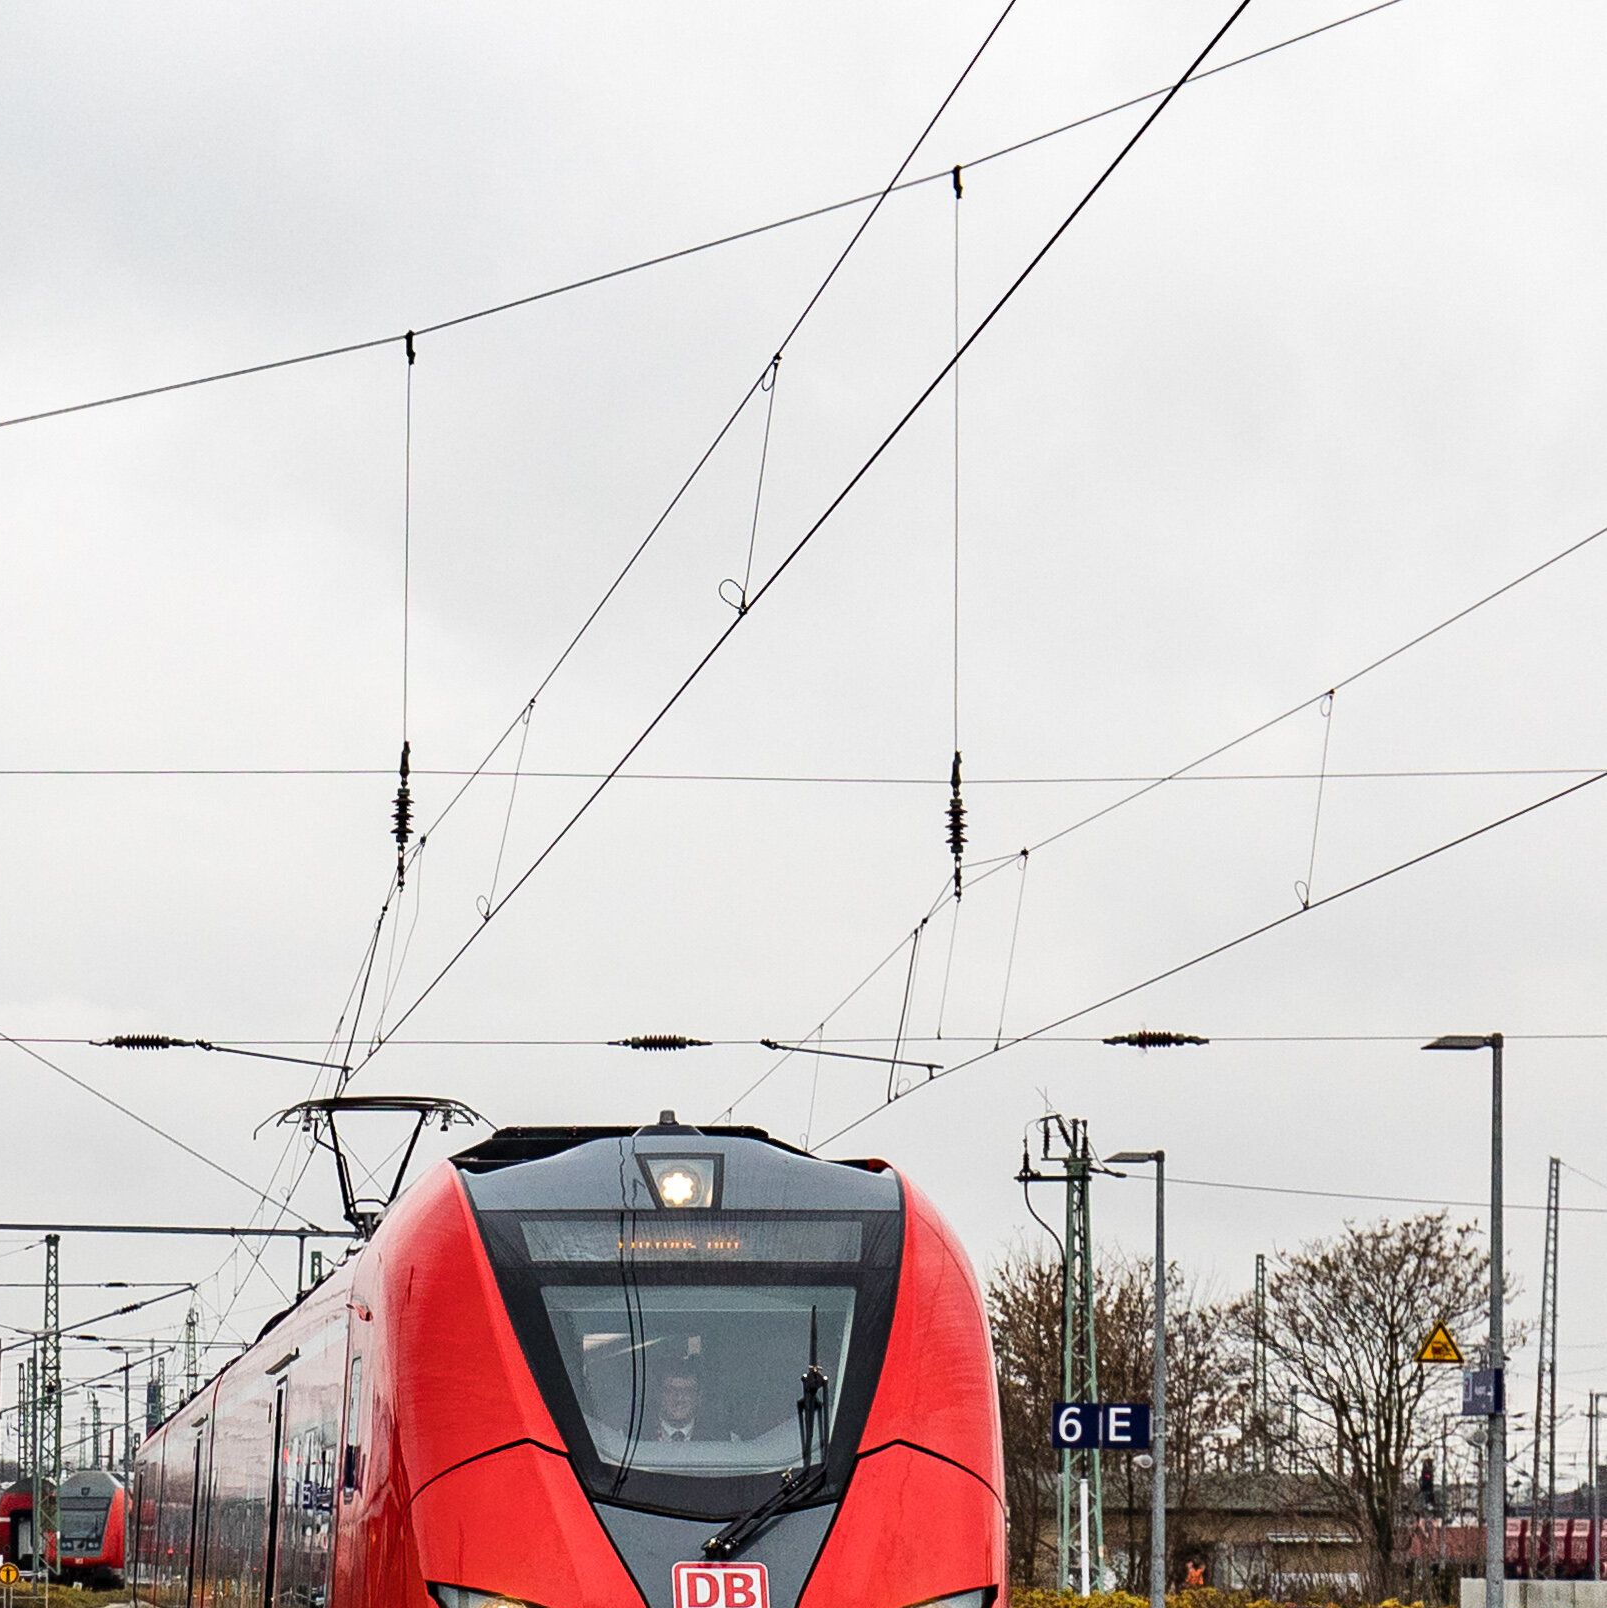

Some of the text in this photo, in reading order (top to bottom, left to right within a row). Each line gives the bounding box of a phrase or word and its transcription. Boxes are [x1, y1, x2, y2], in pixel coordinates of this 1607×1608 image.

[1058, 1406, 1132, 1442] 6 E
[686, 1572, 757, 1608] DB
